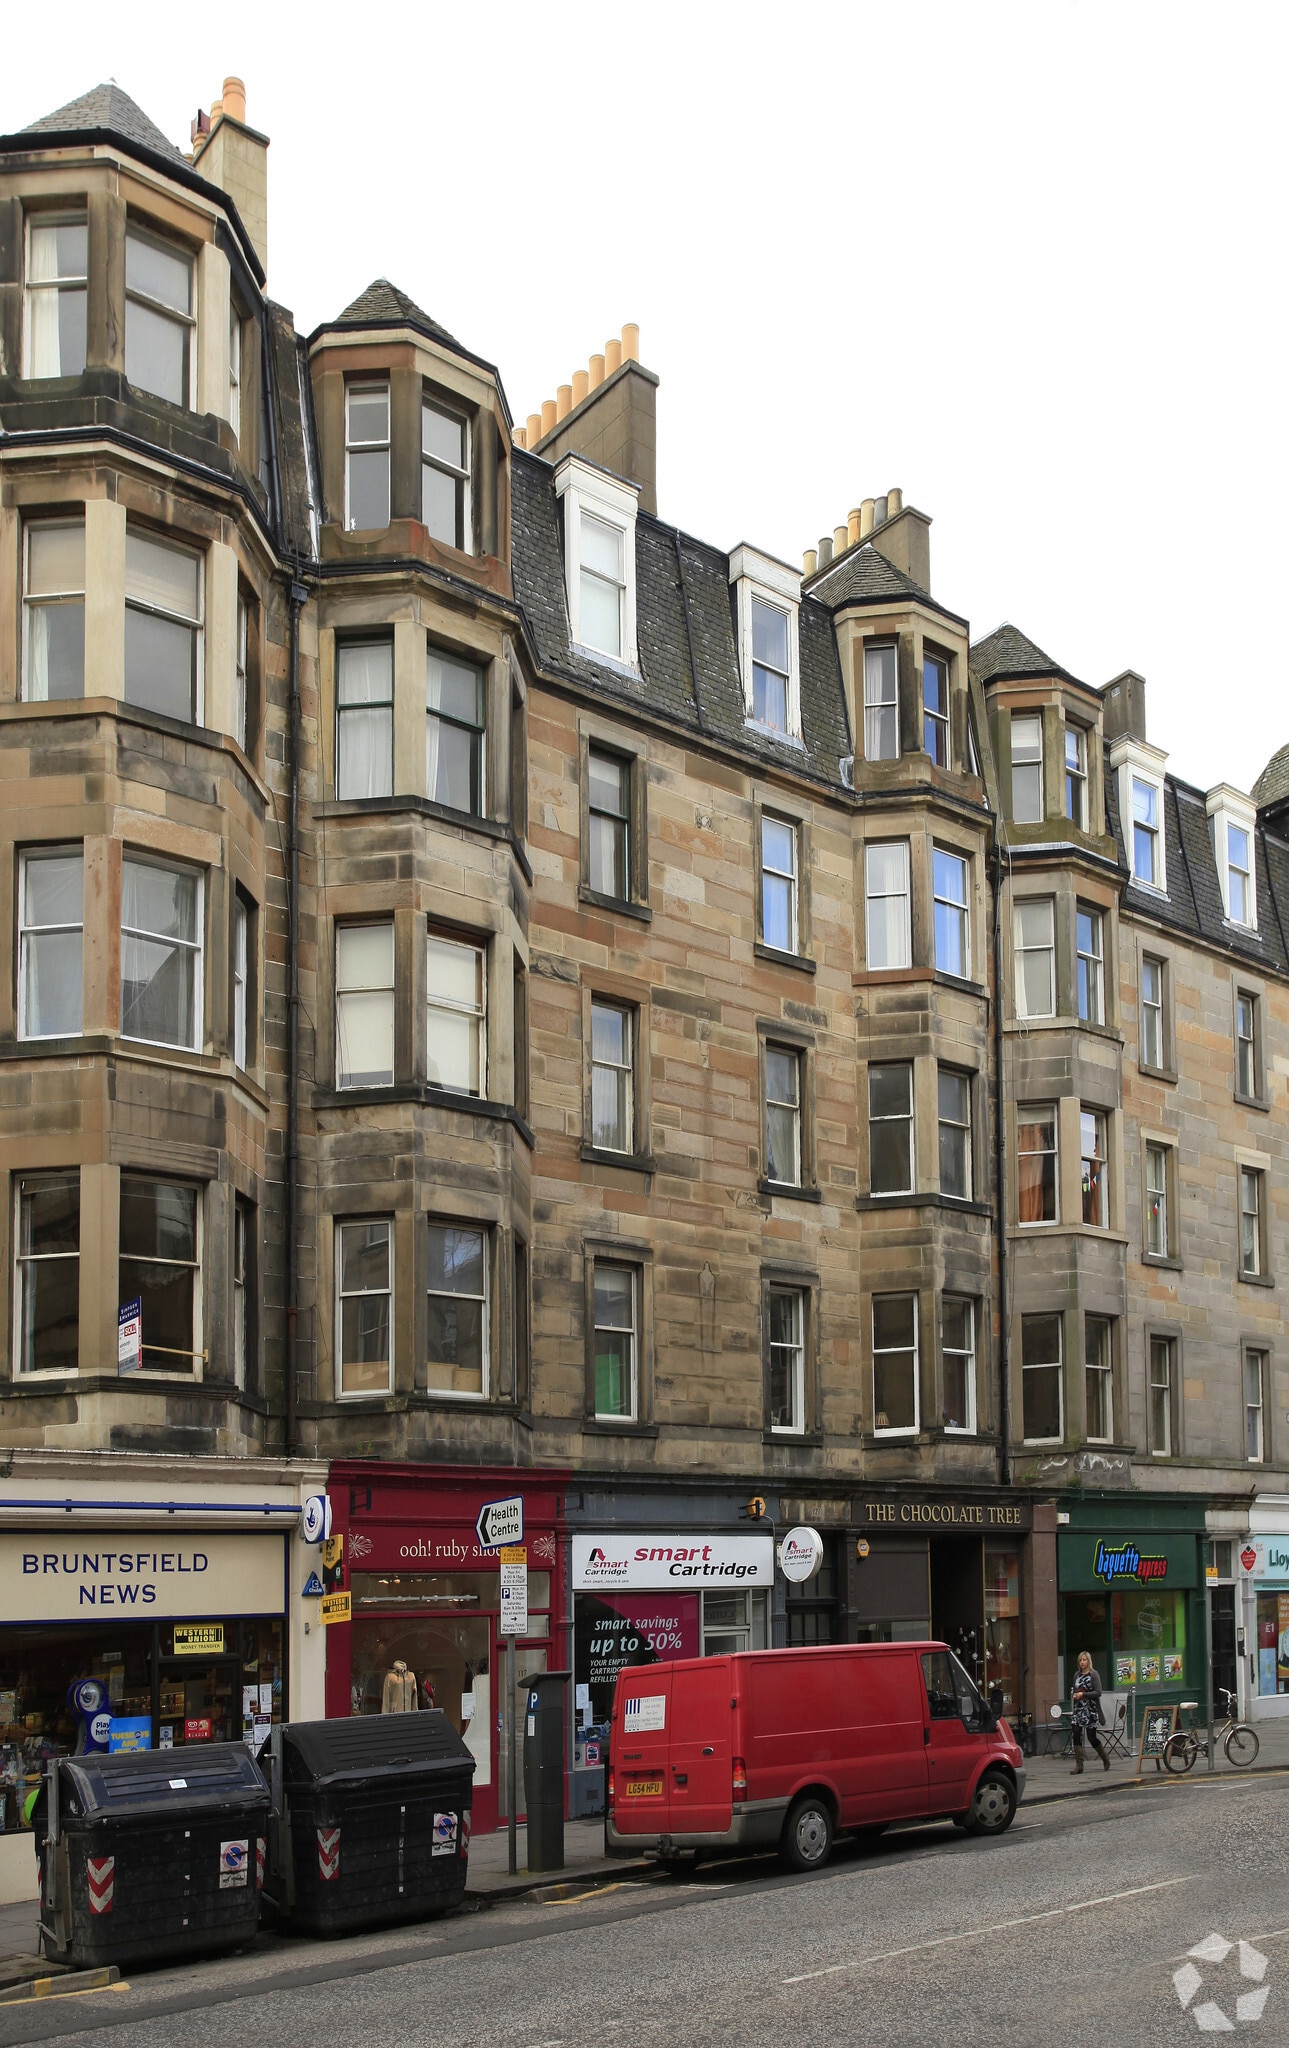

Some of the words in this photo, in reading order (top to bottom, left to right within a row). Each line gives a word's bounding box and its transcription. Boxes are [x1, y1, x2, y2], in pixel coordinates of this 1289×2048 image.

[491, 1505, 518, 1522] Health
[866, 1504, 896, 1522] THE
[901, 1504, 983, 1523] CHOCOLATE
[987, 1507, 1021, 1524] TREE
[490, 1522, 519, 1538] Centre
[400, 1538, 431, 1557] ooh!
[436, 1538, 468, 1562] ruby
[634, 1545, 712, 1562] smart
[784, 1553, 812, 1561] Cartridge
[790, 1547, 813, 1556] smart
[22, 1553, 208, 1574] BRUNTSFIELD
[592, 1560, 629, 1568] smart
[668, 1562, 758, 1578] Cartridge
[1098, 1544, 1138, 1580] baguette
[1138, 1560, 1167, 1582] express
[584, 1568, 627, 1576] Cartridge
[79, 1584, 156, 1604] NEWS
[323, 1597, 346, 1607] WESTERN
[330, 1603, 346, 1612] UNION
[594, 1618, 631, 1630] smart
[634, 1616, 679, 1631] savings
[590, 1637, 615, 1656] up
[620, 1636, 639, 1652] to
[644, 1632, 682, 1651] 50%
[608, 1658, 629, 1666] EMPTY
[590, 1675, 618, 1684] REFILLED
[531, 1693, 538, 1708] P
[628, 1784, 645, 1794] LG54
[646, 1783, 660, 1792] HFU
